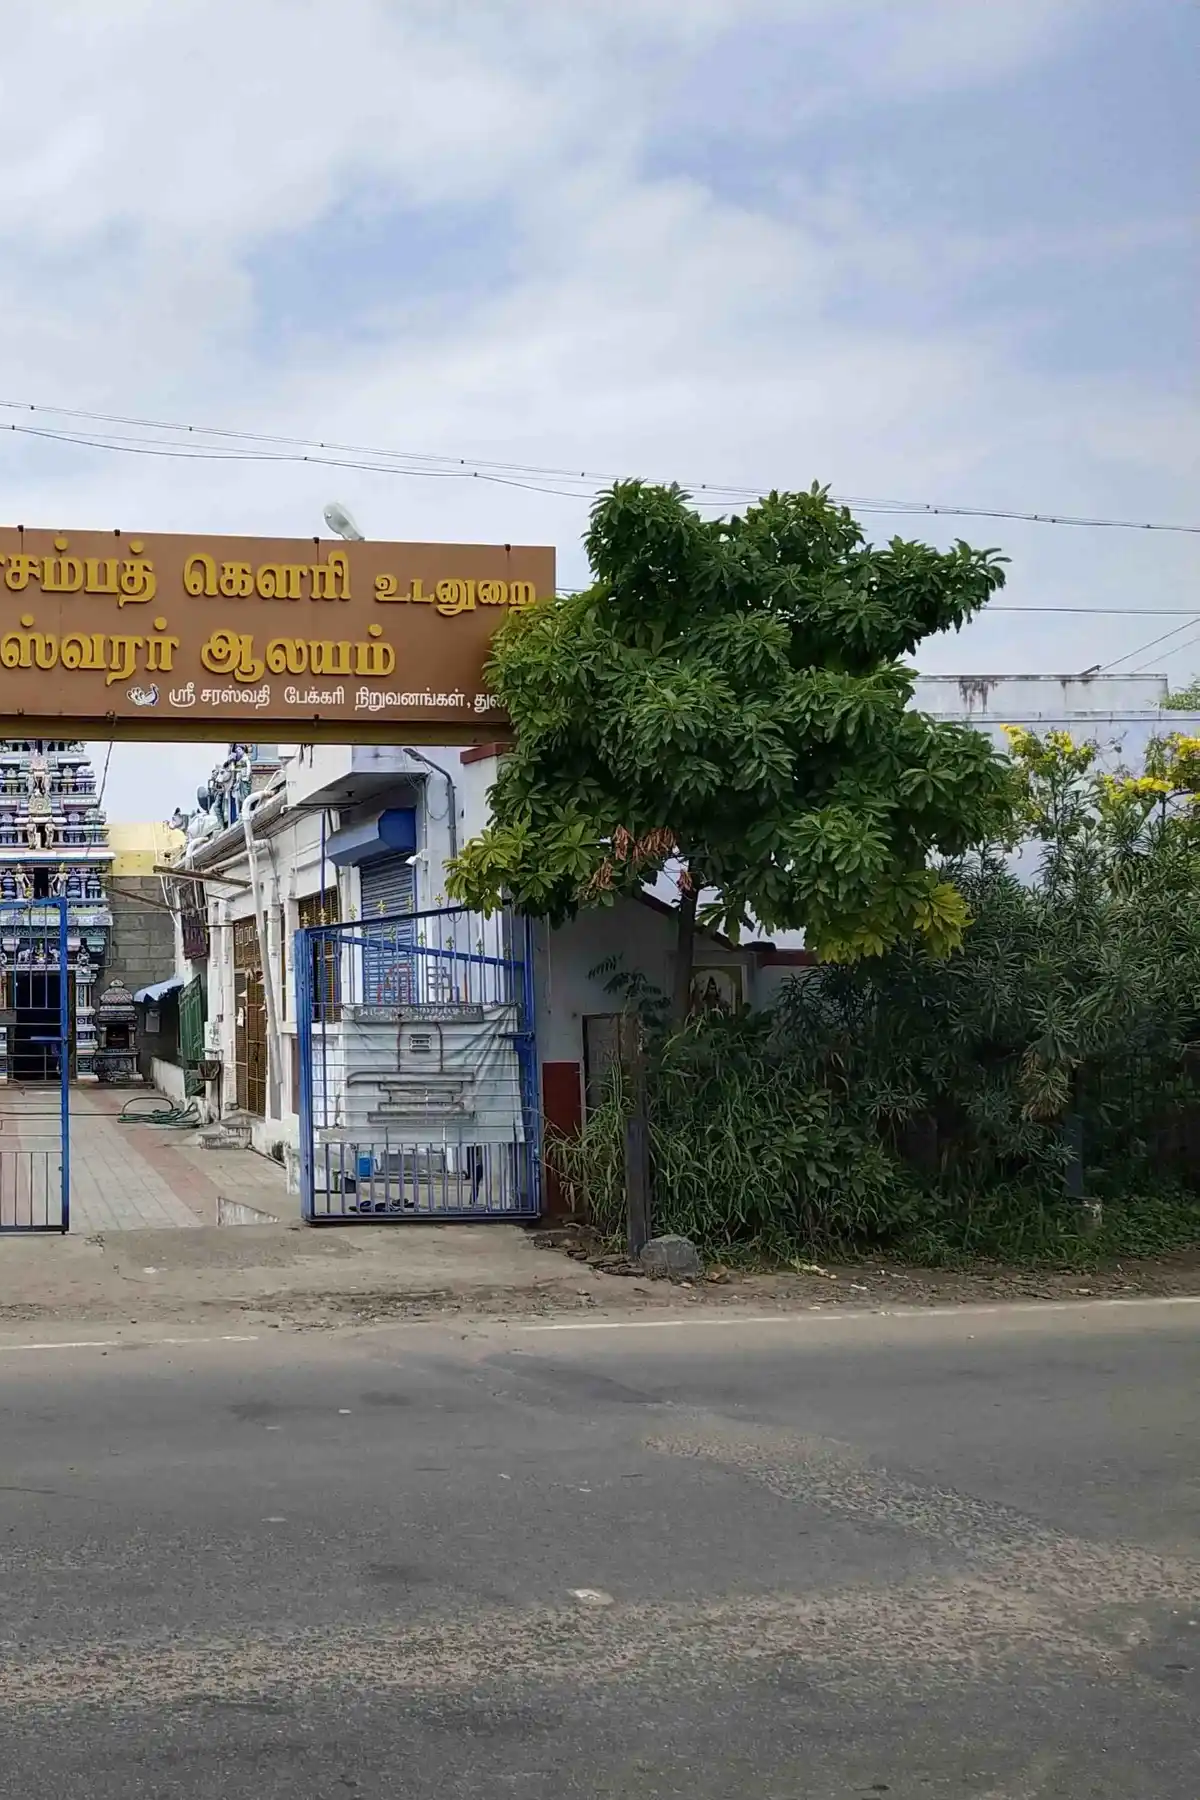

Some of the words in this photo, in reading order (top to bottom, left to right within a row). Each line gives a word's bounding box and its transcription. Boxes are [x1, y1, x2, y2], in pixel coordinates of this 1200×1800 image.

[374, 573, 537, 616] உடனுறை
[201, 624, 395, 682] ஆலயம்
[200, 685, 271, 709] சரஸ்வதி
[284, 685, 345, 705] பேக்கரி
